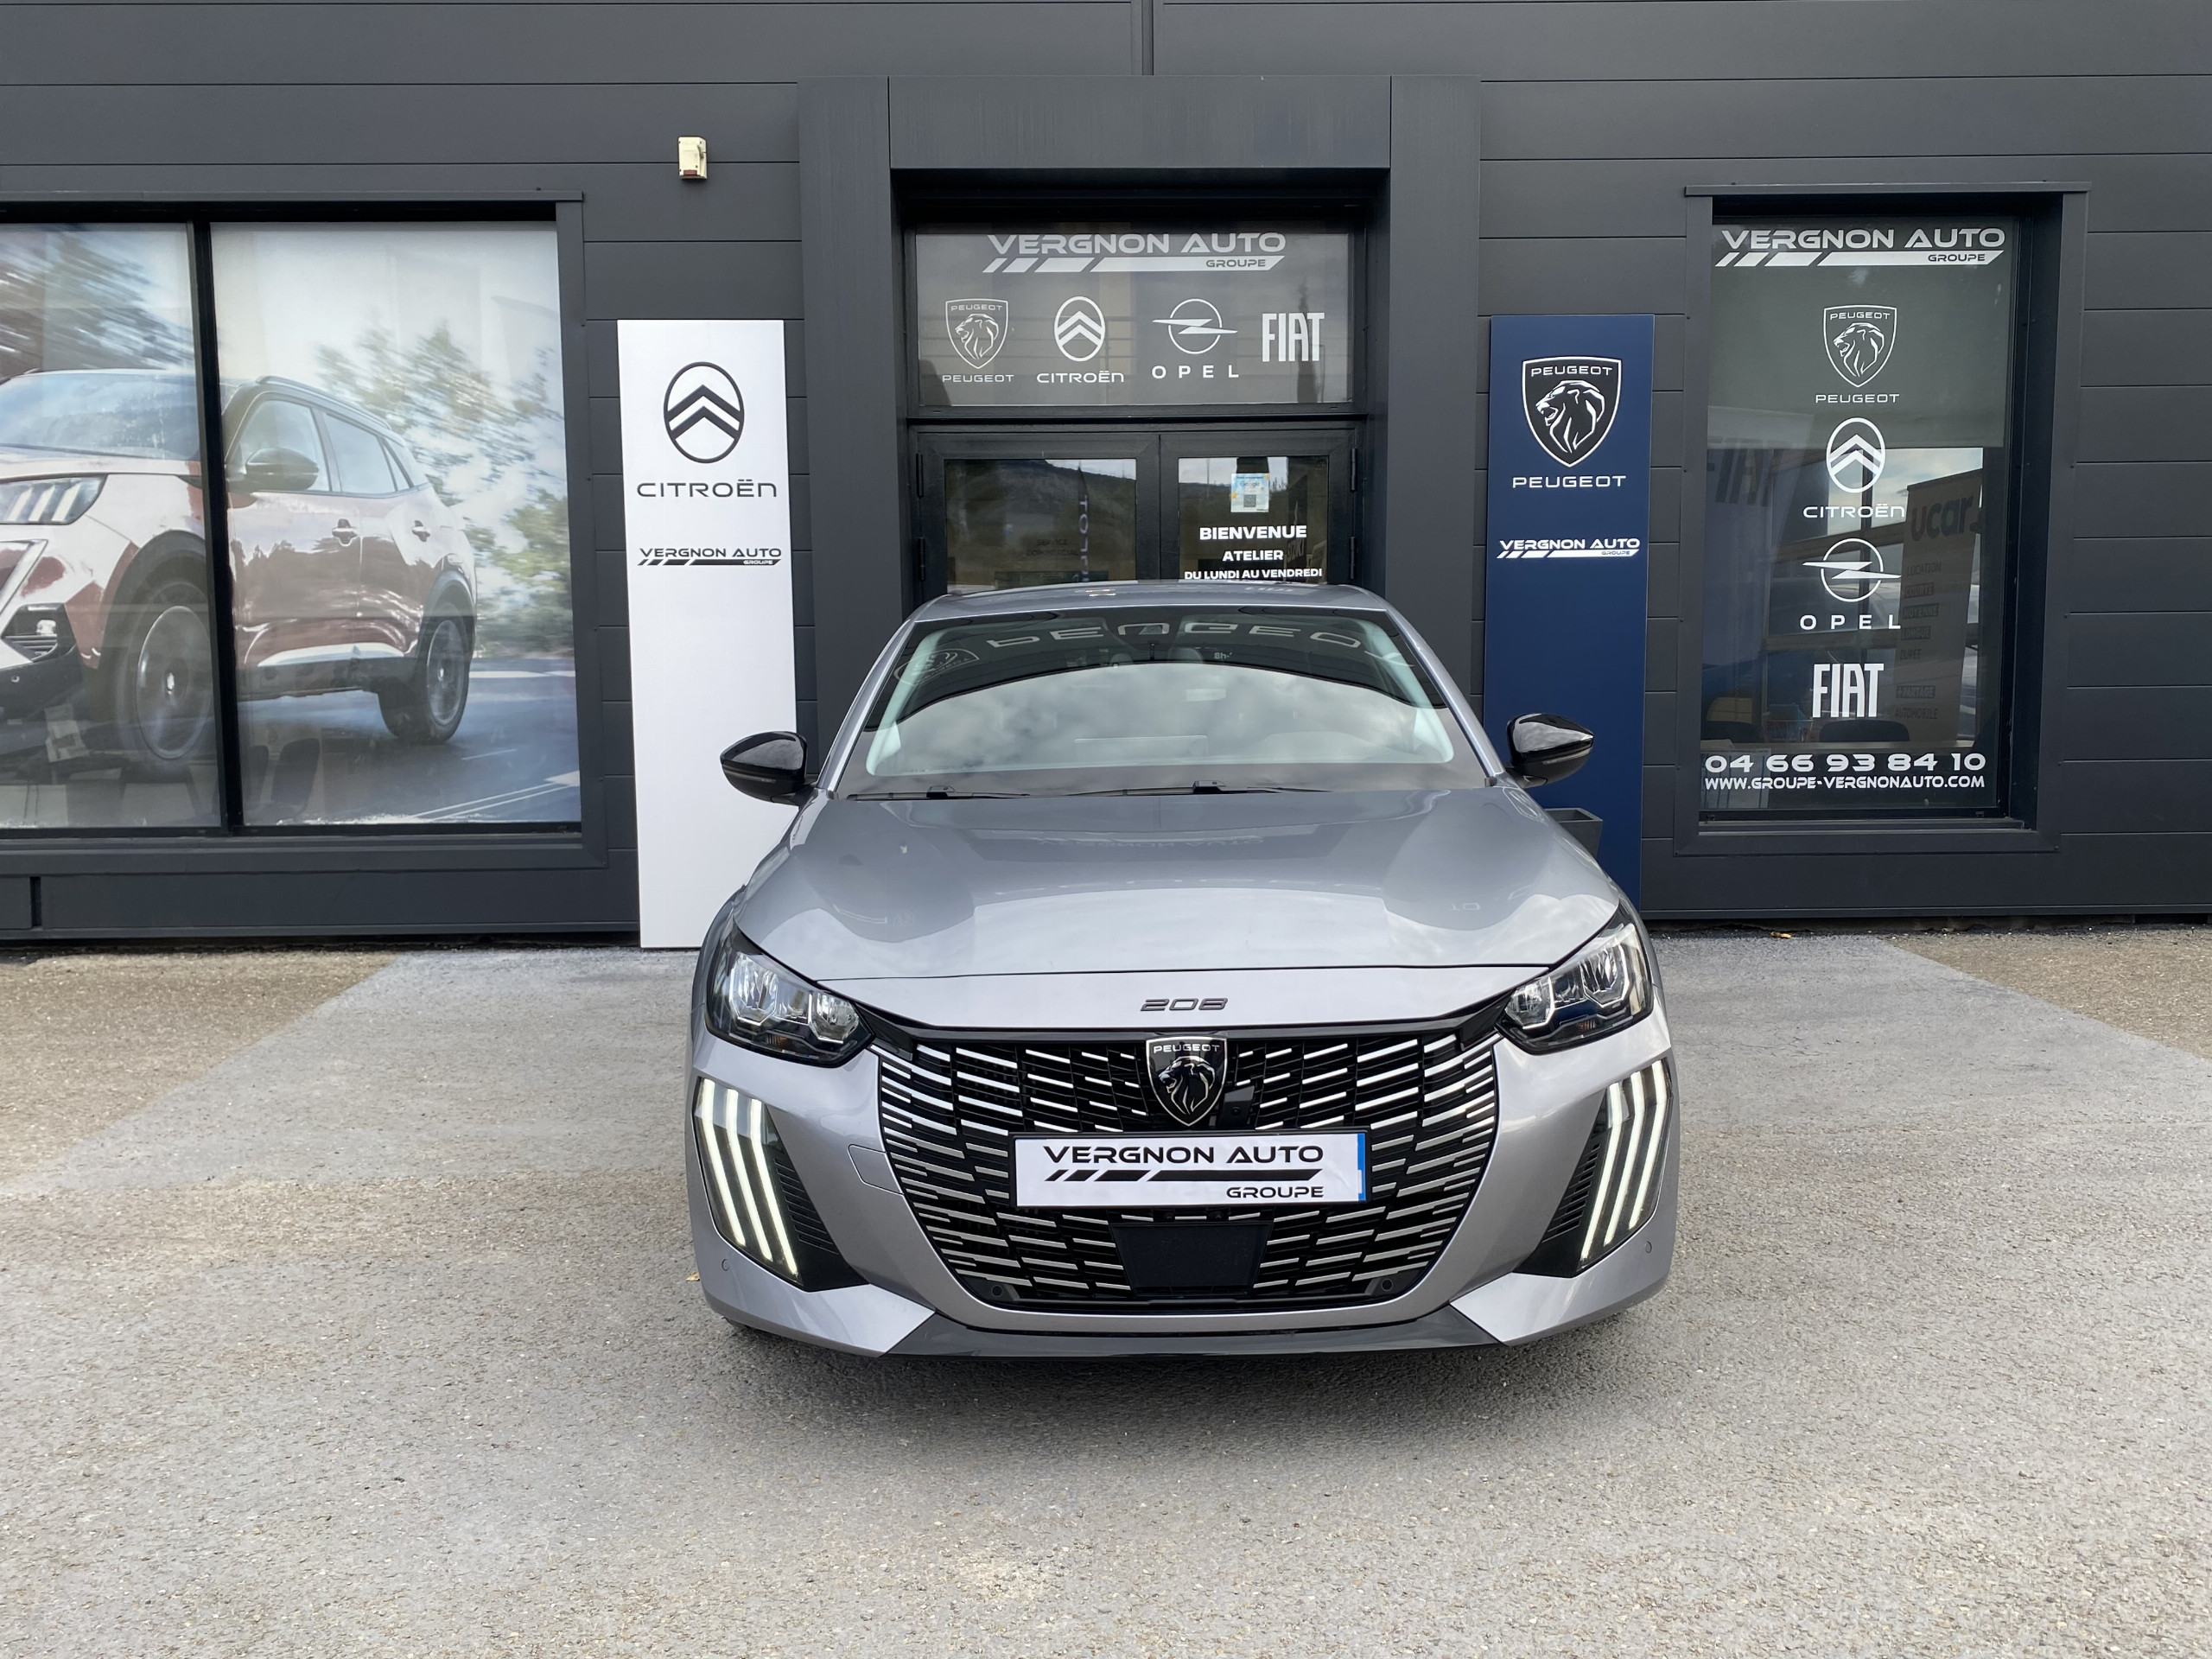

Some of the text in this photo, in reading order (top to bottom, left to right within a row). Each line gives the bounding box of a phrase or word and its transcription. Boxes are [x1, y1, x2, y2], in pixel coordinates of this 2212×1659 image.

[987, 232, 1287, 255] VERGNON AUTO
[1721, 227, 2005, 250] VERGNON AUTO
[1205, 258, 1266, 268] GROUPE
[1928, 253, 1985, 262] GROUPE
[950, 303, 1003, 312] PEUGEOT
[1829, 311, 1891, 321] PEUGEOT
[1262, 312, 1325, 362] FIAT
[1036, 370, 1124, 384] CITROËN
[1152, 365, 1239, 379] OPEL
[1530, 365, 1612, 377] PEUGEOT
[943, 374, 1014, 383] PEUGEOT
[1815, 393, 1900, 404] PEUGEOT
[1512, 475, 1626, 488] PEUGEOT
[637, 479, 778, 498] CITROËN
[1802, 504, 1905, 518] CITROËN
[1199, 525, 1307, 540] BIENVENUE
[1500, 537, 1641, 550] VERGNON AUTO
[639, 548, 782, 557] VERGNON AUTO
[1222, 550, 1284, 562] ATELIER
[1184, 568, 1323, 580] DU LUNDI AU VENDREDI
[1800, 614, 1901, 630] OPEL
[1812, 663, 1885, 717] FIAT
[1705, 753, 1986, 772] 04 66 93 84 10
[1705, 775, 1986, 791] WWW.GROUPE-VERGNONAUTO.COM
[1140, 998, 1229, 1012] 208
[1154, 1043, 1220, 1054] PEUGEOT
[1043, 1146, 1325, 1164] VERGNON AUTO
[1226, 1186, 1325, 1198] GROUPE
